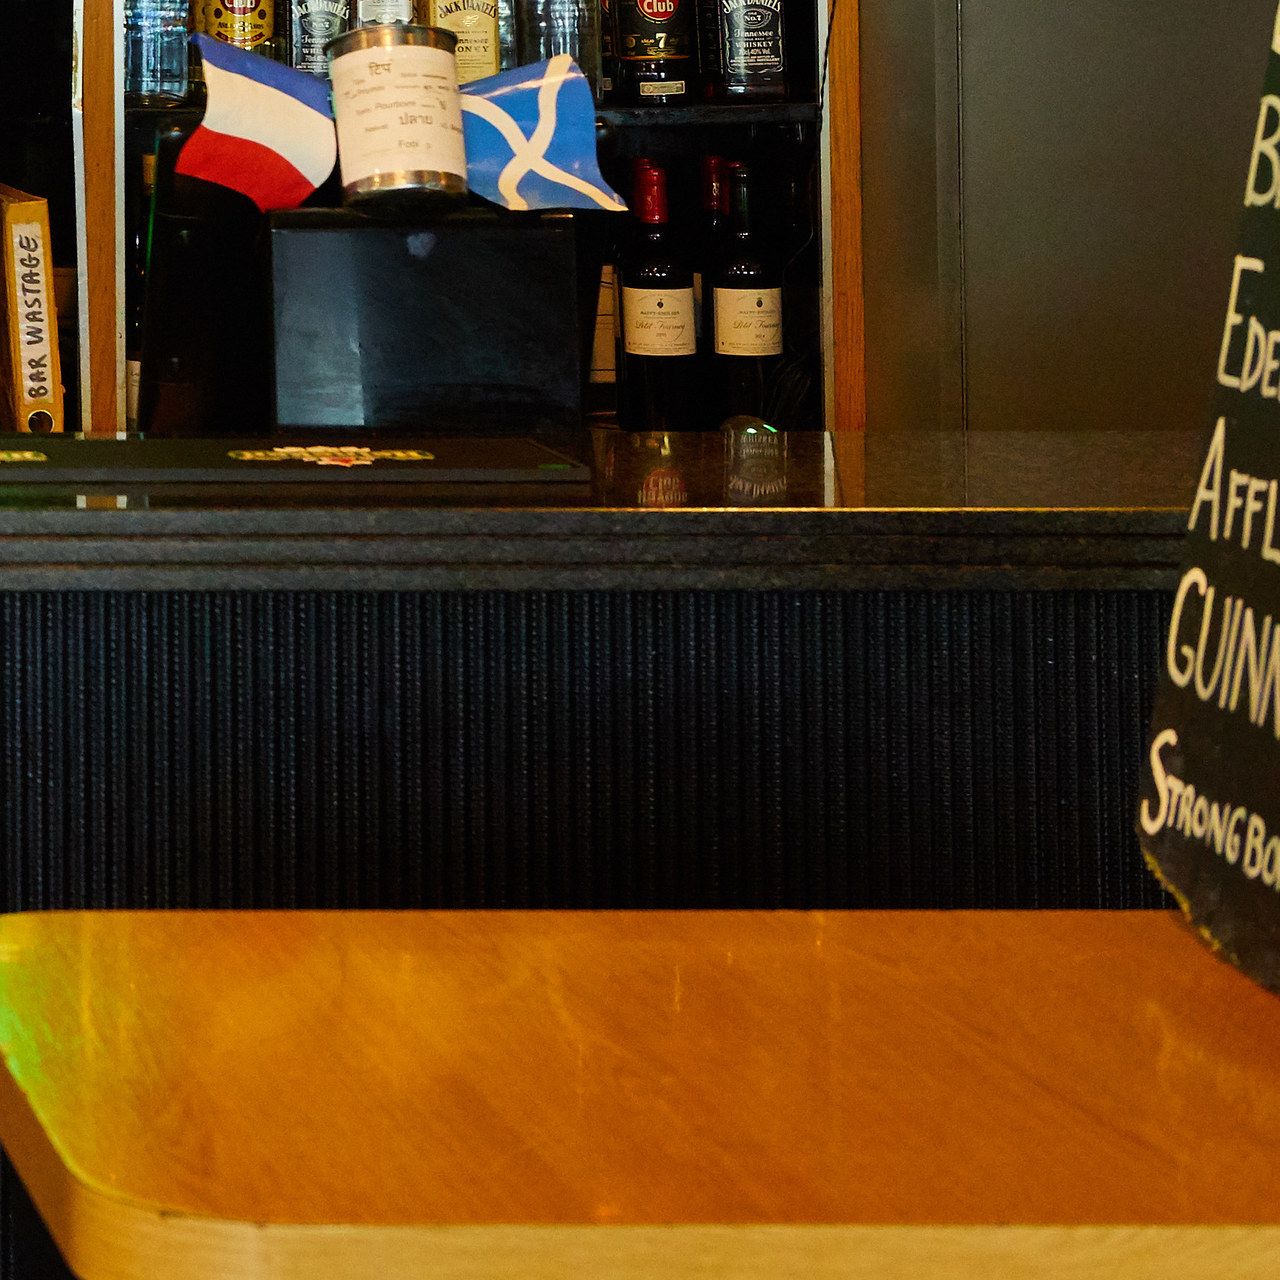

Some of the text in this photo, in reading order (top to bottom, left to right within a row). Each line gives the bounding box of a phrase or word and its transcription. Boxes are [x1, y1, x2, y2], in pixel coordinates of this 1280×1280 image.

[439, 0, 461, 19] JACK
[642, 0, 674, 13] Club
[655, 32, 668, 49] 7
[735, 40, 774, 48] WHISKEY
[16, 233, 49, 401] BAR WASTAGE
